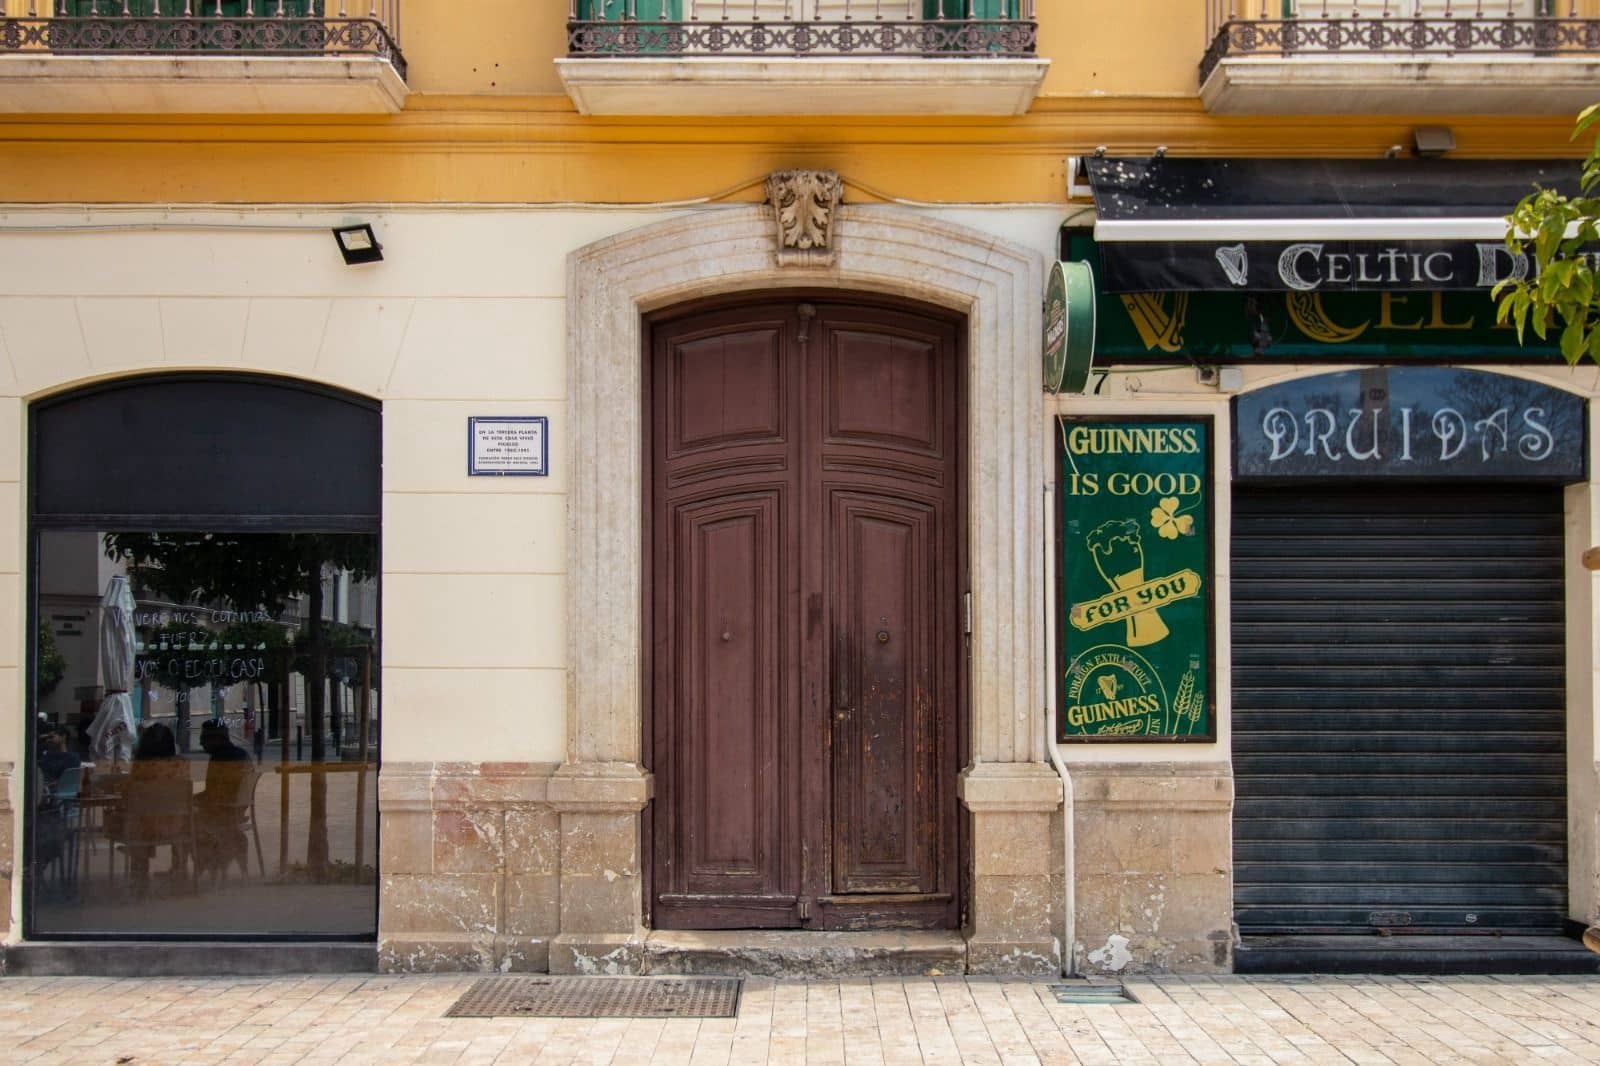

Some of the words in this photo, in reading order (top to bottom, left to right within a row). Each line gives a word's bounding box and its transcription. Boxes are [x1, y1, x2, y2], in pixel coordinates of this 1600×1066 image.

[1092, 369, 1110, 395] 7
[1263, 407, 1553, 463] DRUIDAS
[1070, 473, 1099, 496] IS
[1107, 472, 1202, 496] GOOD
[1085, 597, 1130, 623] FOR
[1136, 576, 1187, 606] YOU
[1068, 693, 1161, 727] GUINNESS
